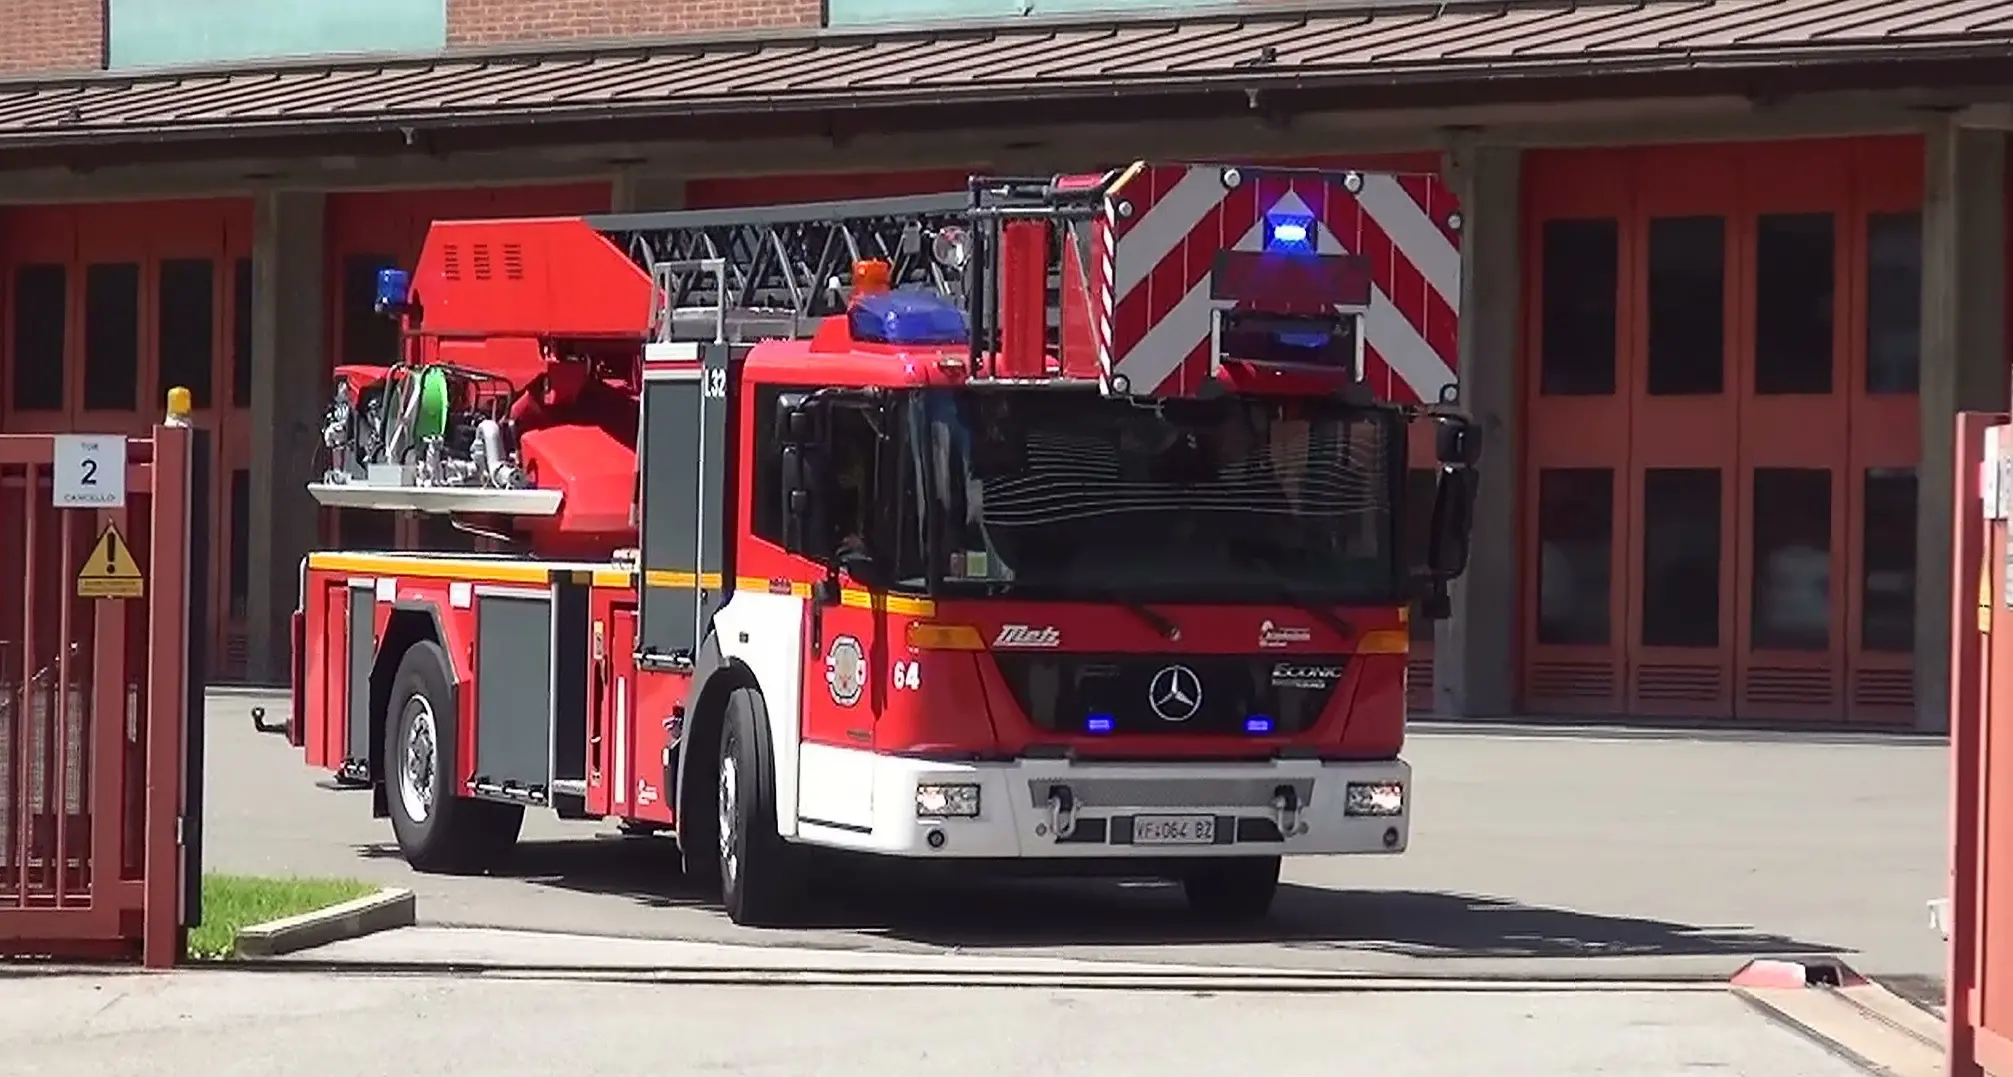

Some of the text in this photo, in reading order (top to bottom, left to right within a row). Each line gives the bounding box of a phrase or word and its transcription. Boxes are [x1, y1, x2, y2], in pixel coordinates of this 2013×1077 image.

[704, 368, 727, 397] L32
[80, 459, 98, 486] 2
[893, 660, 921, 690] 64
